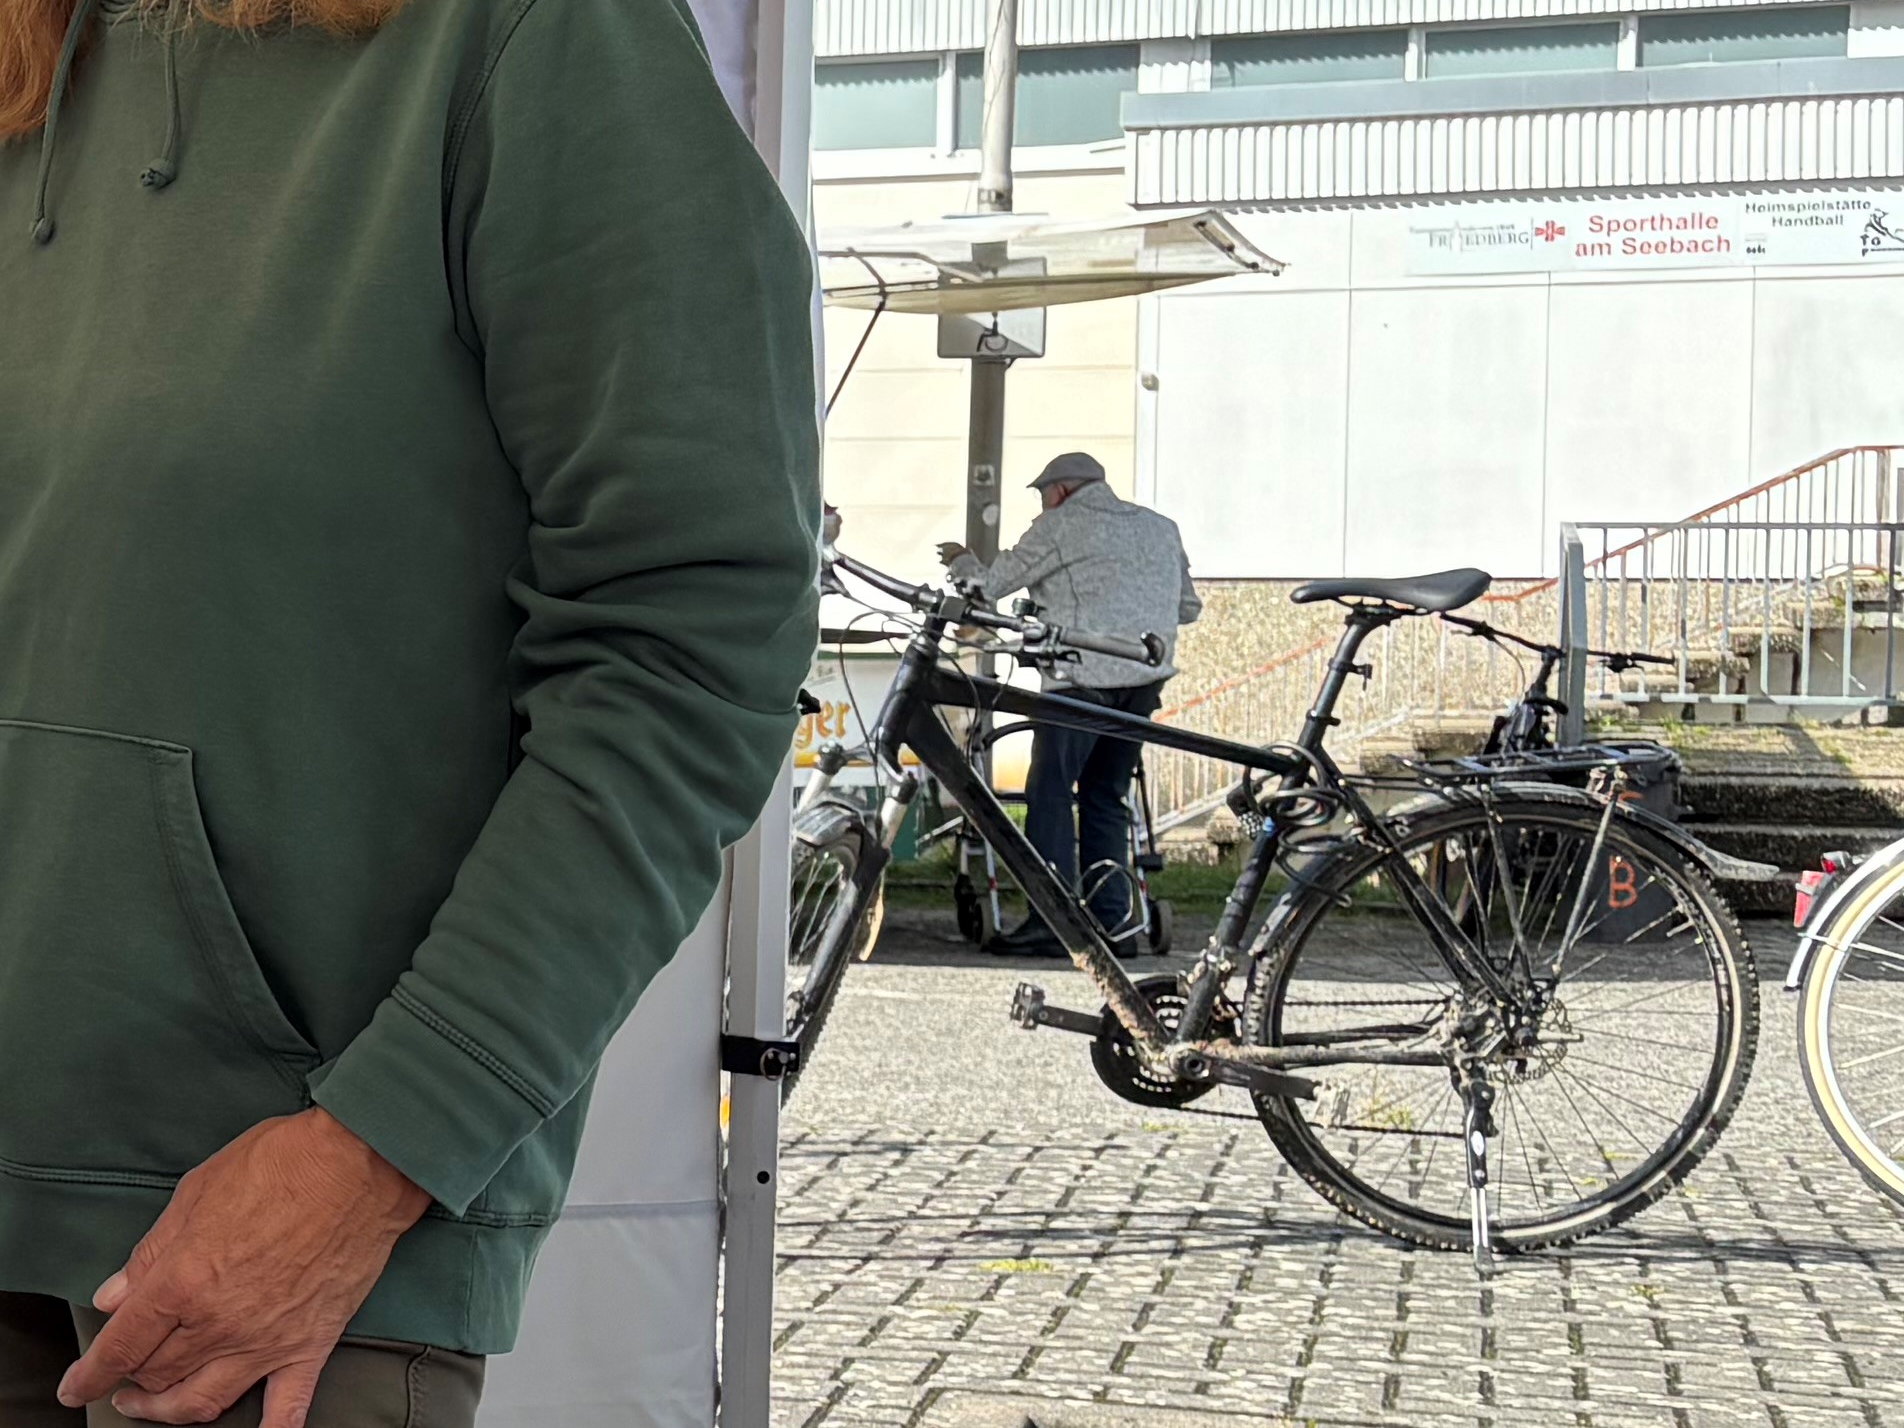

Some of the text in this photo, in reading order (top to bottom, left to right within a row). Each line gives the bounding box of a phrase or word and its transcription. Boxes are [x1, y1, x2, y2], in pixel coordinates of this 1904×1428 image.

[1587, 213, 1720, 236] Sporthalle
[1771, 215, 1845, 230] Handball
[1575, 240, 1613, 257] am
[1621, 234, 1732, 256] Seebach
